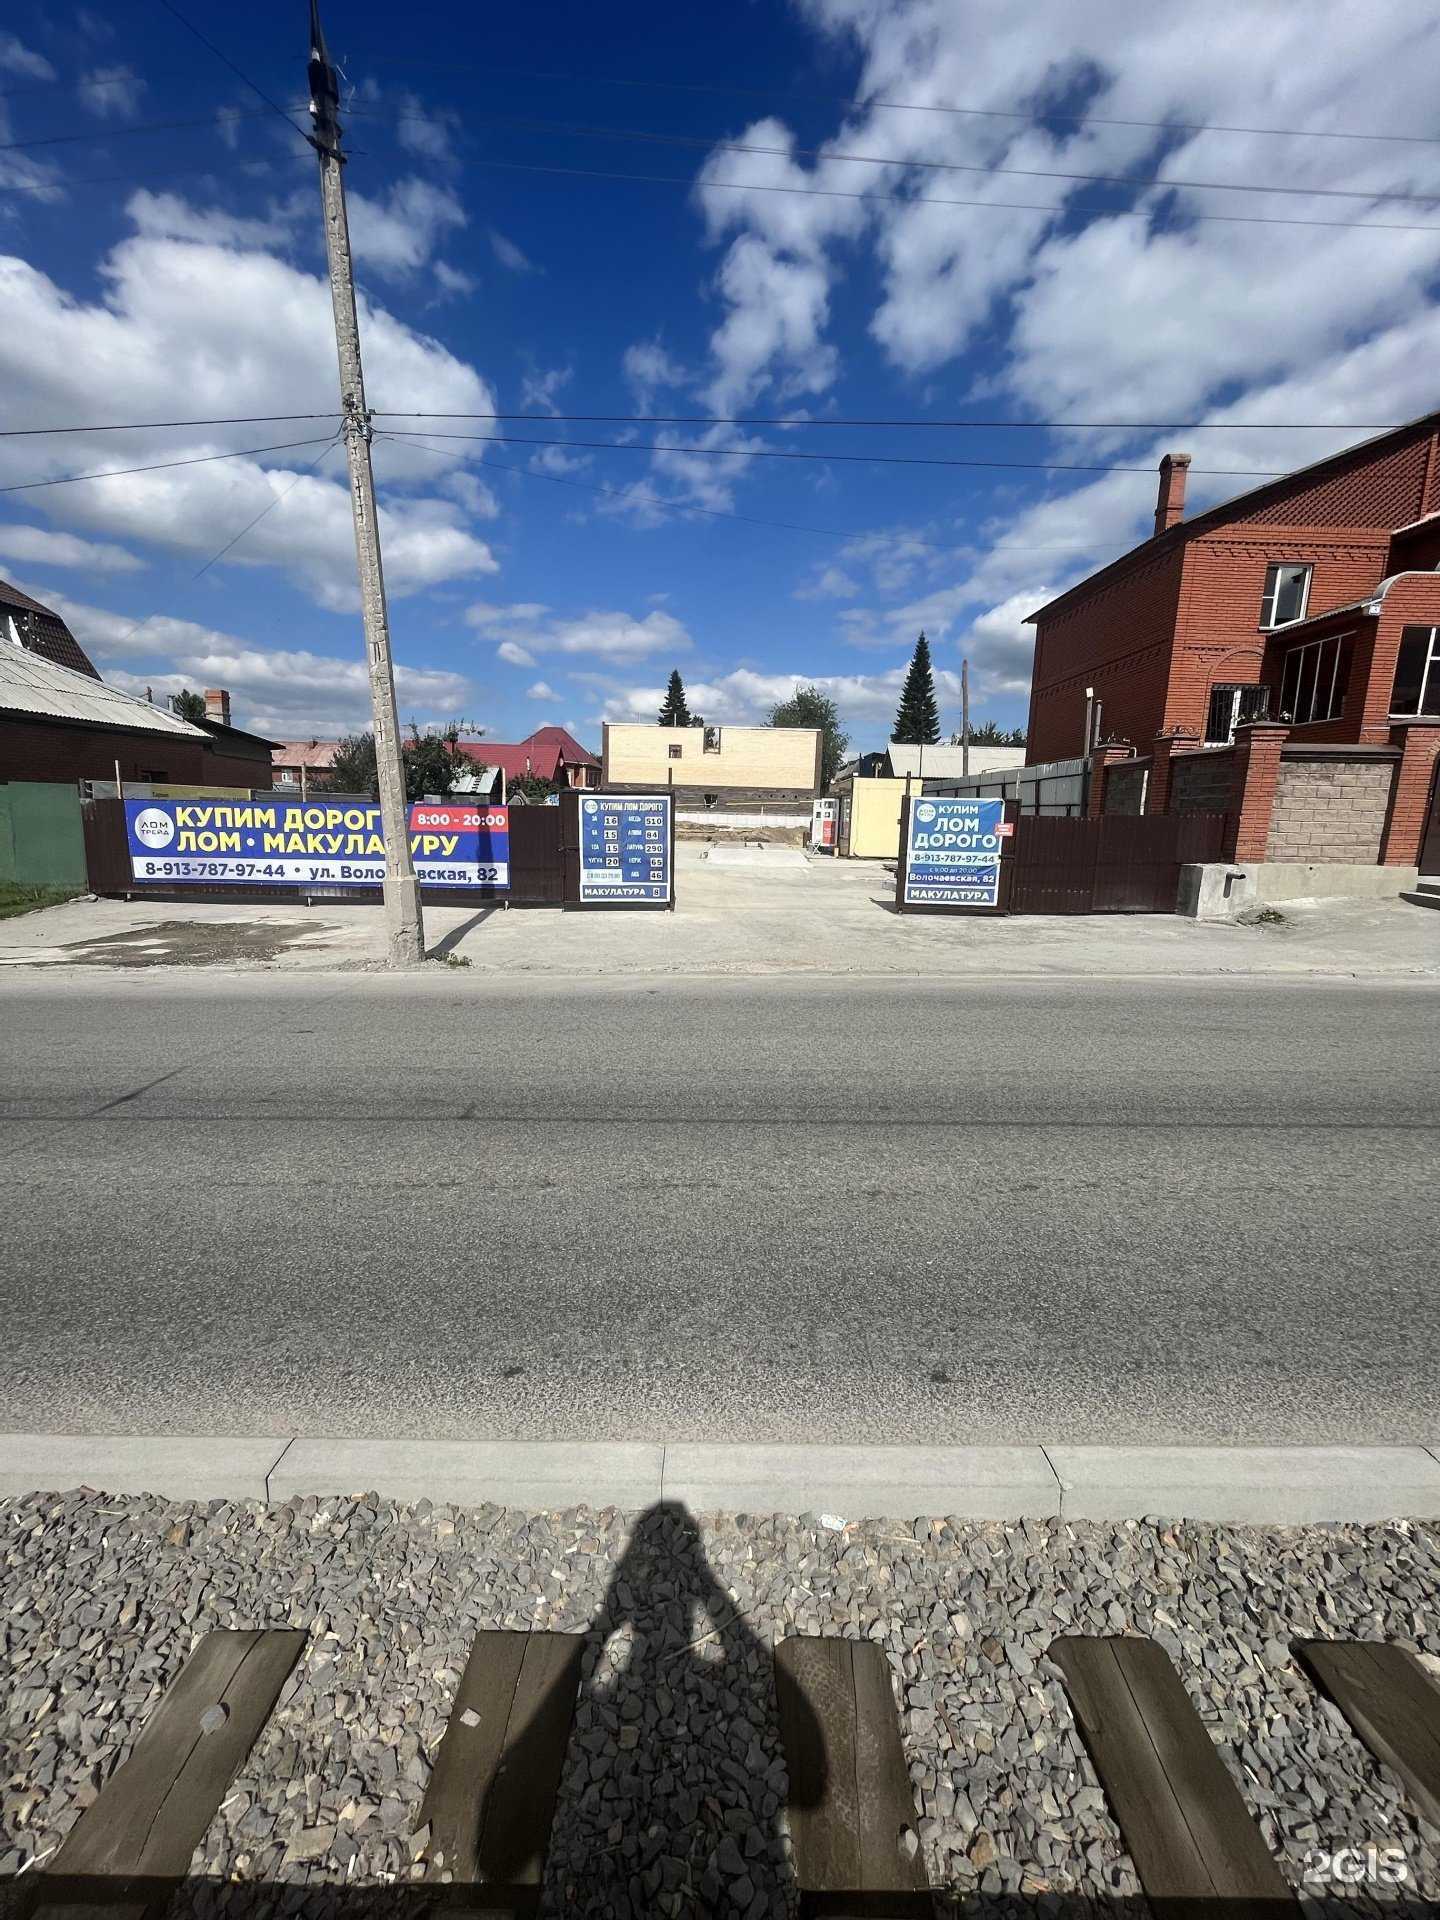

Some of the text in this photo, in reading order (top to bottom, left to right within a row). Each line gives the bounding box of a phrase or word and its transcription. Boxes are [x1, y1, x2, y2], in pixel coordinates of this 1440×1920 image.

[600, 802, 622, 811] КУПИМ
[624, 802, 638, 811] ЛОМ
[639, 802, 663, 812] ДОРОГО
[938, 805, 979, 814] КУПИМ
[176, 807, 382, 832] КУПИМ ДОРОГ
[417, 814, 449, 825] 8:00
[463, 814, 505, 826] 20:00
[605, 817, 617, 825] 16
[934, 818, 980, 832] ЛОМ
[604, 831, 617, 839] 15
[177, 832, 459, 856] ЛОМ МАКУЛАУРУ
[915, 833, 997, 849] ДОРОГО
[607, 858, 618, 866] 20
[914, 853, 995, 864] 8-913-787-97-44
[145, 862, 498, 883] 8-913-787-97-44 ул. Воловская, 82
[909, 873, 995, 883] Волочаевская, 82
[584, 888, 646, 896] МАКУЛАТУРА
[910, 889, 990, 900] МАКУЛАТУРА
